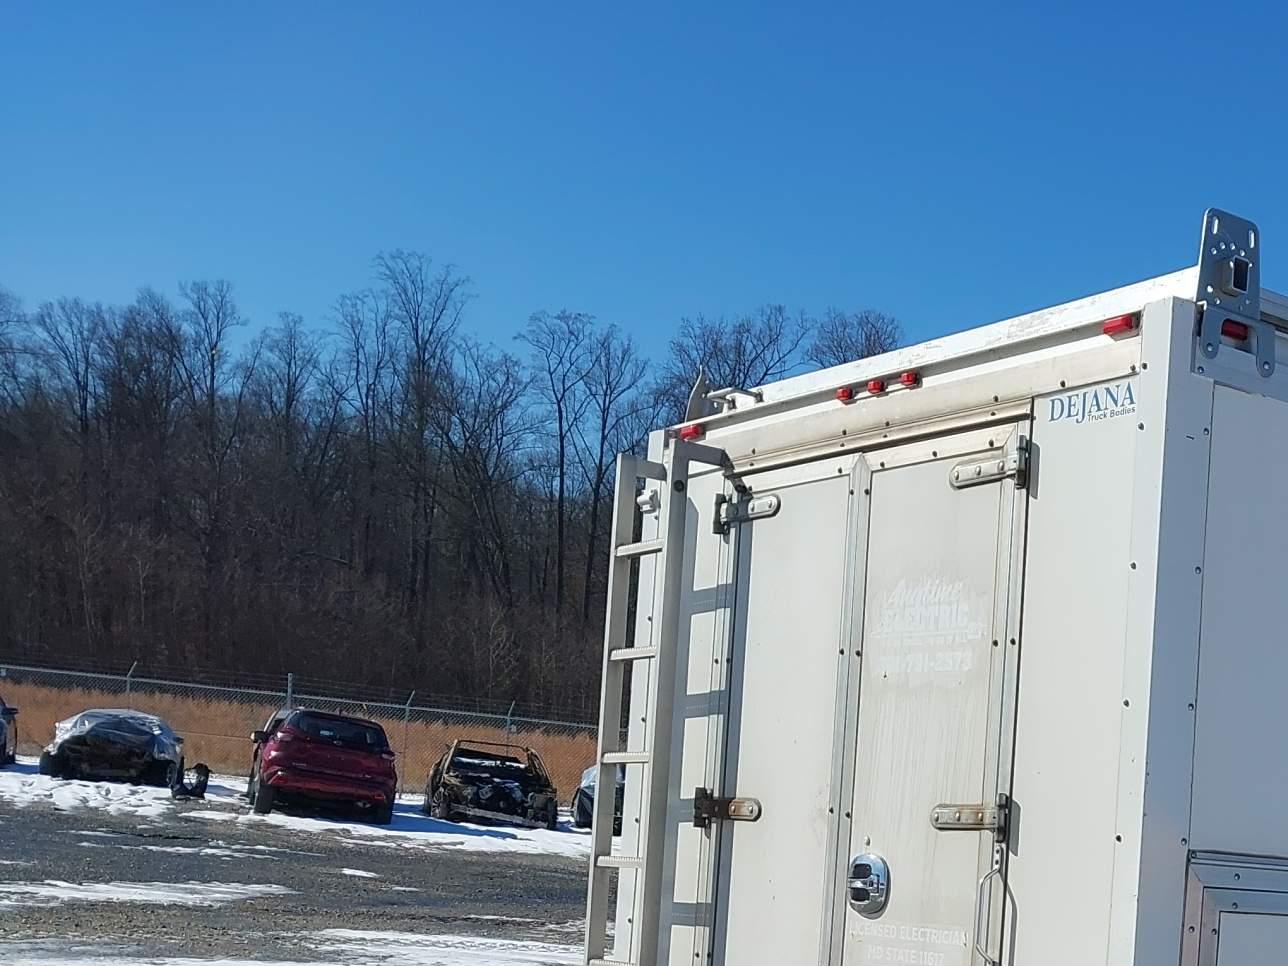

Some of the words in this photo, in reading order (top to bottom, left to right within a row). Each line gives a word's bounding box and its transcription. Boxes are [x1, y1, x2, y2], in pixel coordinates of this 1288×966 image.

[1049, 381, 1136, 424] DEJANA
[1087, 412, 1108, 423] Truck
[1109, 406, 1136, 419] Bodies
[850, 921, 897, 939] LICENSED
[900, 926, 968, 946] ELECTRICIAN
[886, 948, 917, 964] STATE
